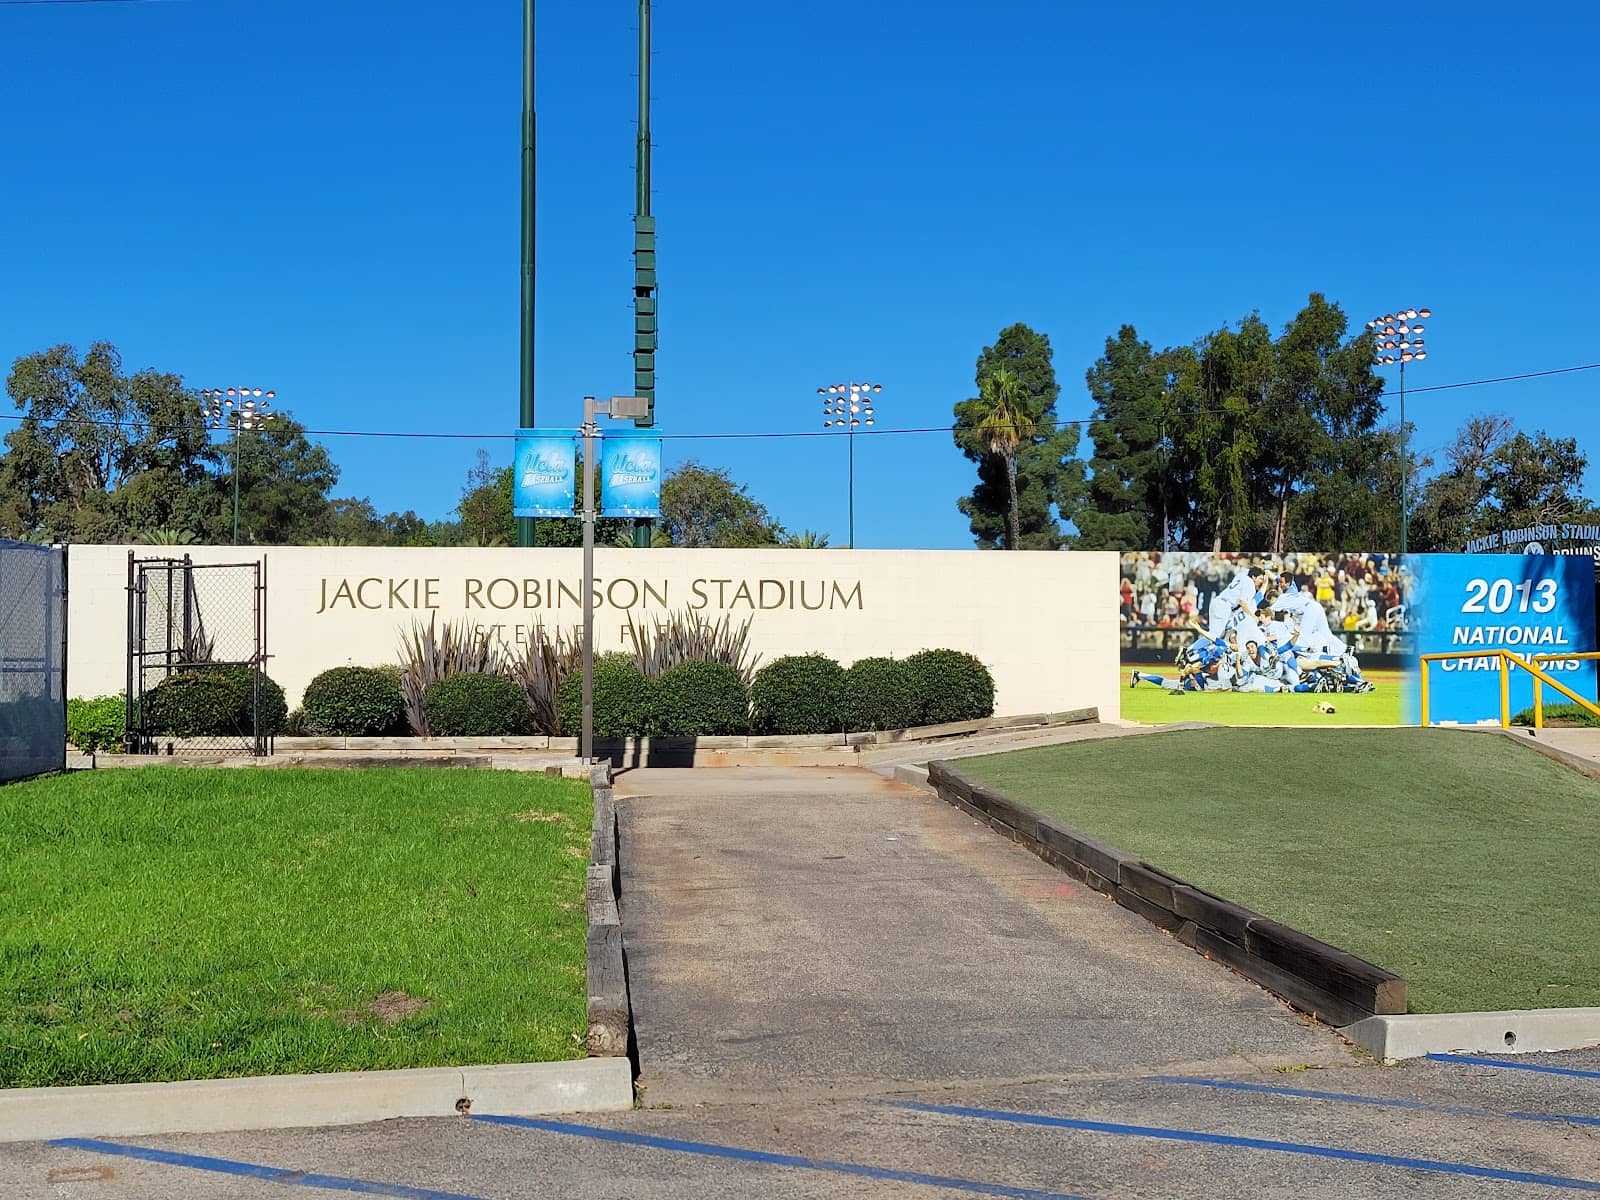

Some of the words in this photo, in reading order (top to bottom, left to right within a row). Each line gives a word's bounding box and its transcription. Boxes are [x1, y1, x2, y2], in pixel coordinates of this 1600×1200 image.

[1466, 534, 1498, 554] JACKIE
[1502, 525, 1557, 545] ROBINSON
[316, 577, 440, 614] JACKIE
[465, 577, 668, 610] ROBINSON
[692, 578, 864, 610] STADIUM
[1462, 578, 1557, 613] 2013
[1453, 626, 1568, 645] NATIONAL
